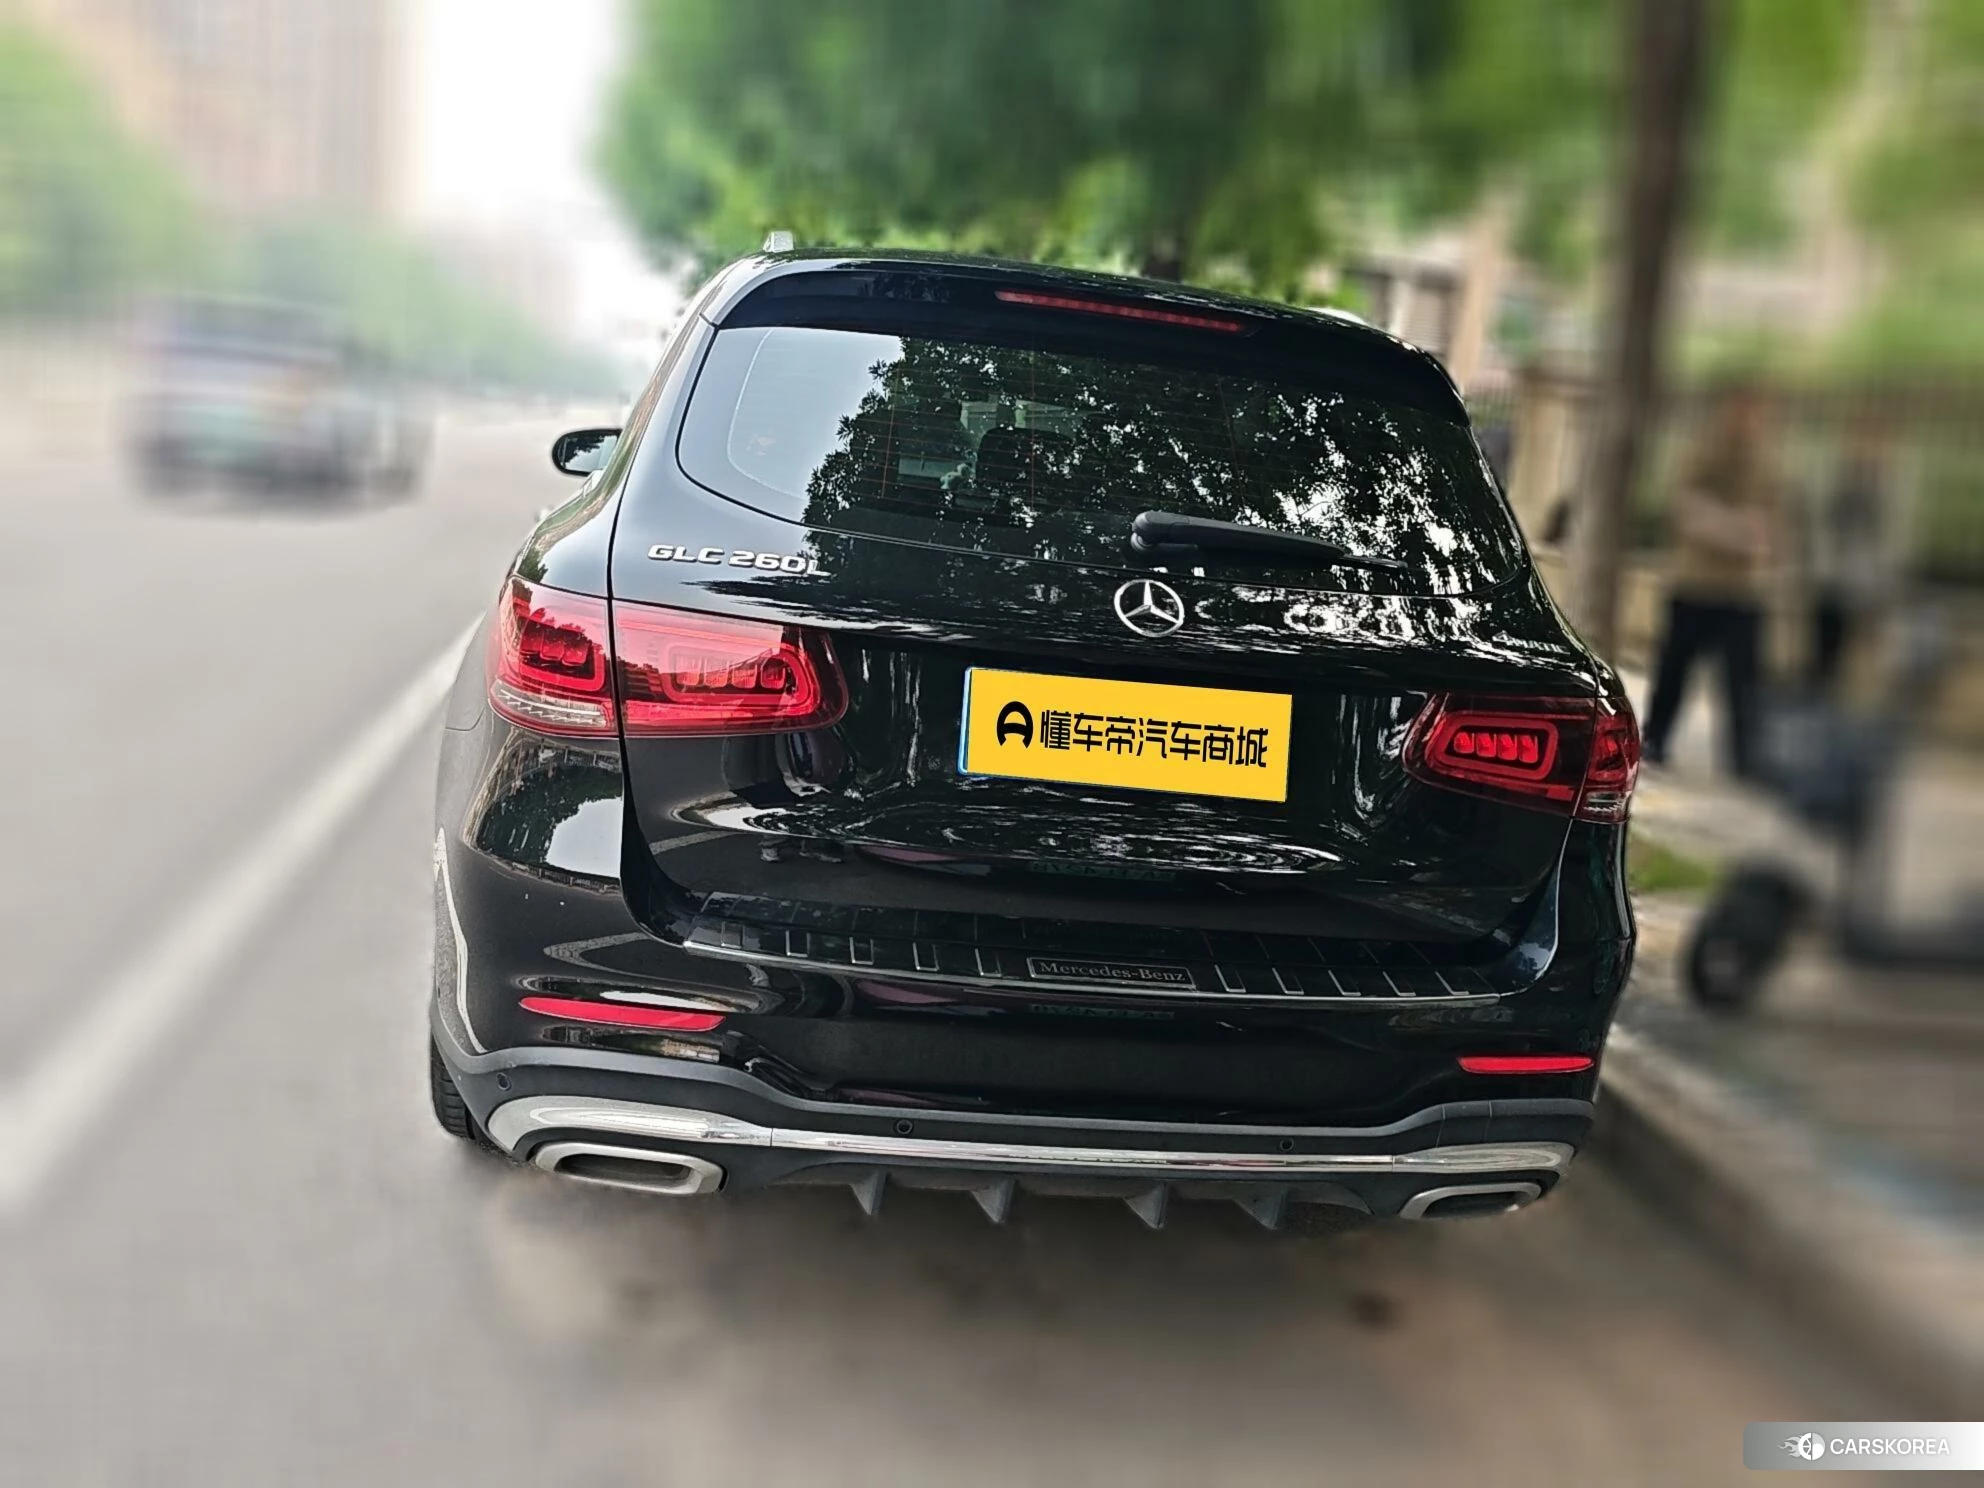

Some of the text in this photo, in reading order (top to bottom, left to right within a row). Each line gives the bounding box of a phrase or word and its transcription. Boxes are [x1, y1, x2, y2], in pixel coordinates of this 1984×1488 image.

[648, 544, 831, 577] GLC 260L
[1039, 961, 1186, 982] Mercedes-Benz
